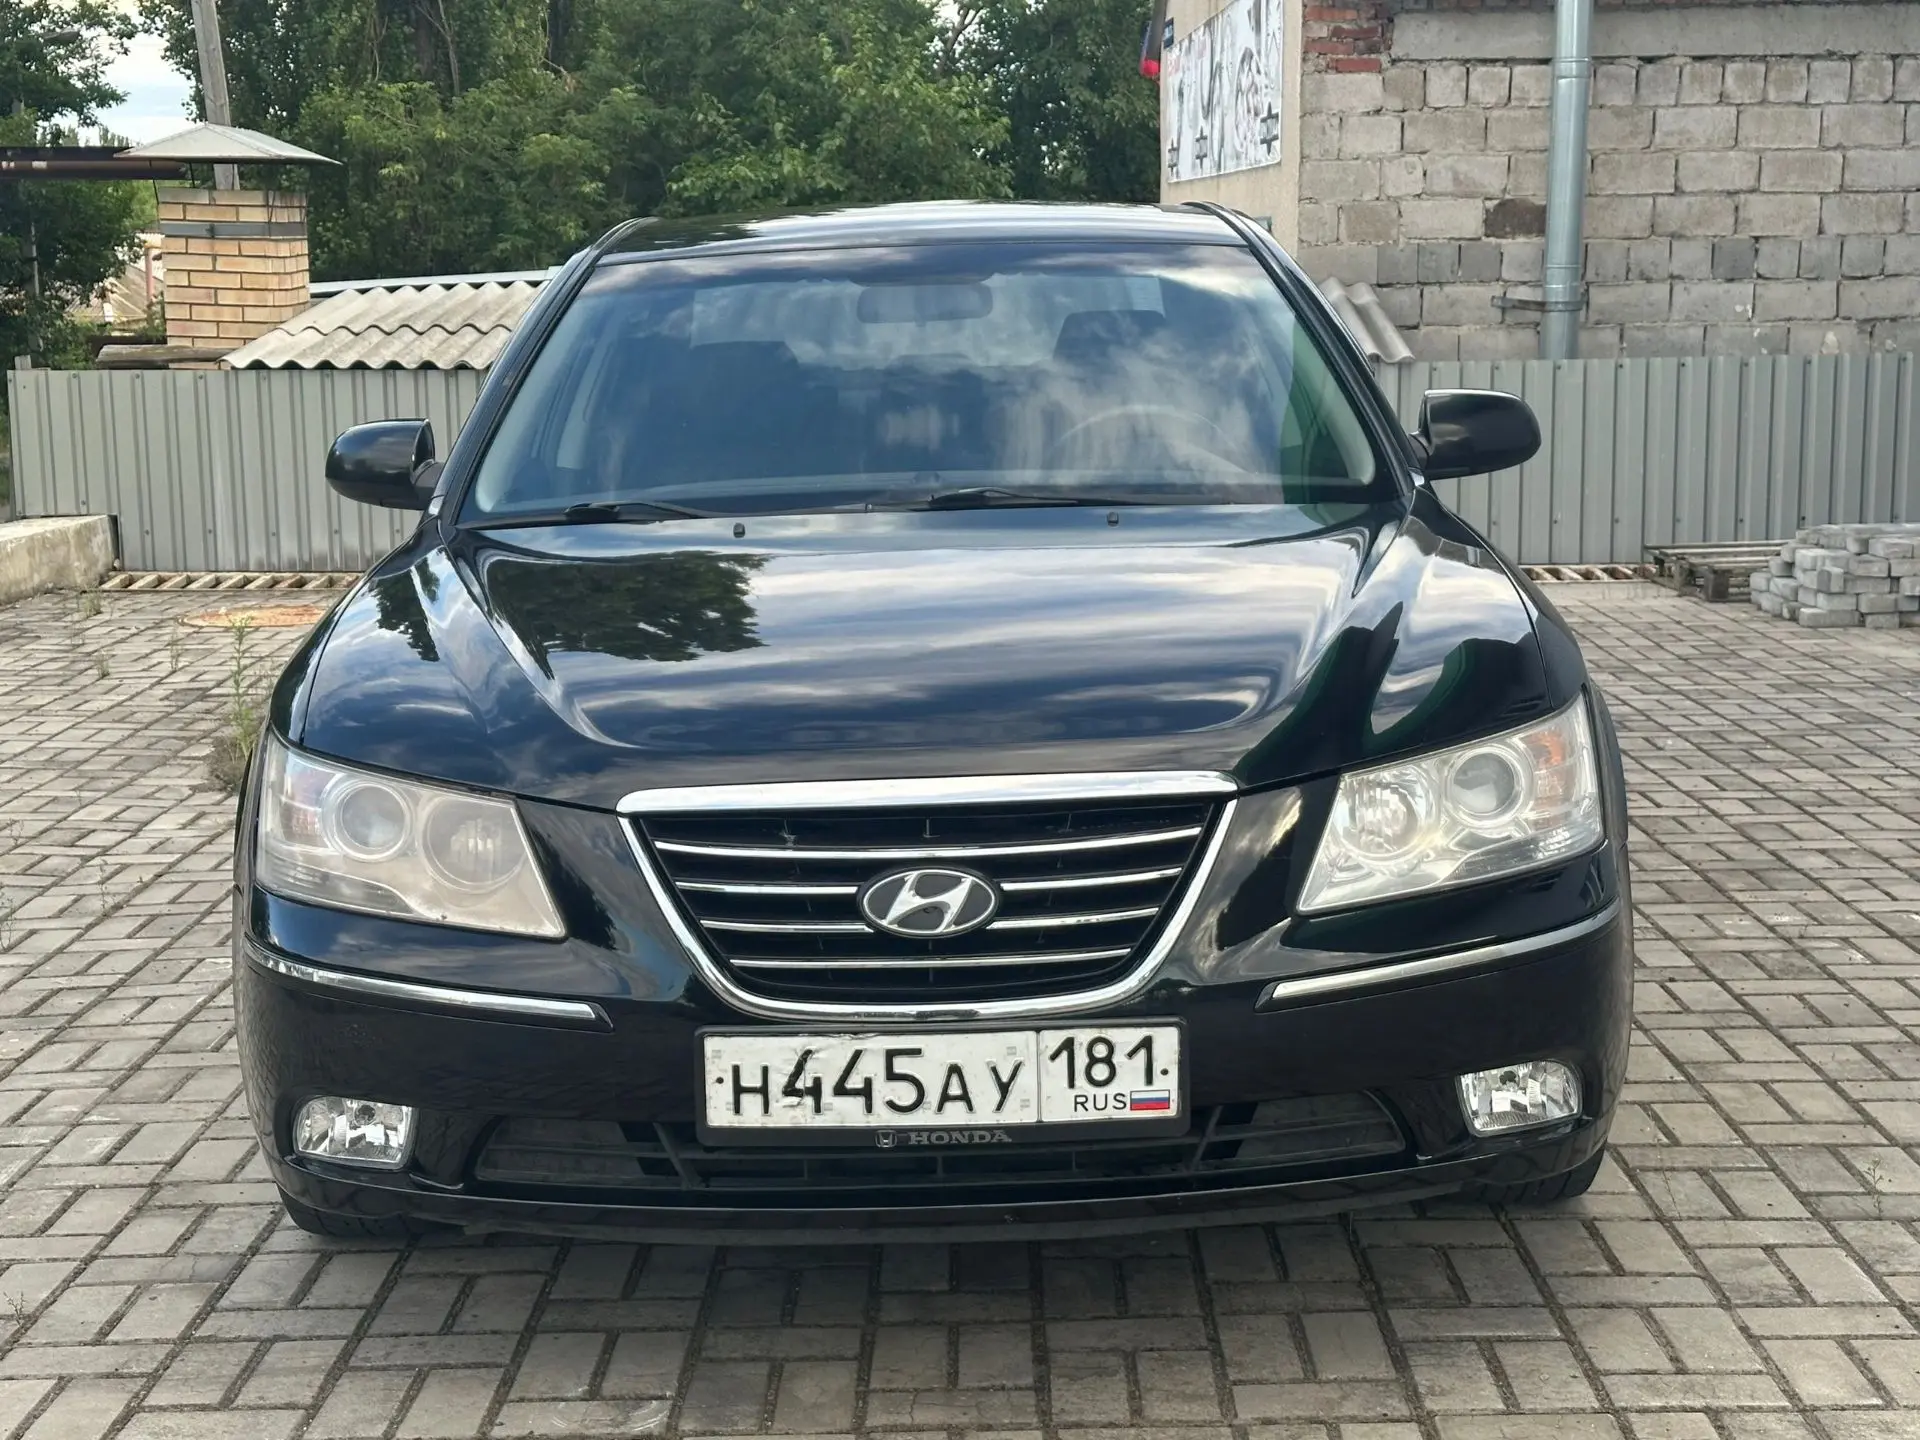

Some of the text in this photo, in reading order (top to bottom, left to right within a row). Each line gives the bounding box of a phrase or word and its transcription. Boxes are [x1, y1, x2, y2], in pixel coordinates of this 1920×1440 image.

[1049, 1034, 1154, 1088] 181
[1073, 1092, 1128, 1112] RUS
[908, 1129, 1012, 1145] HONDA
